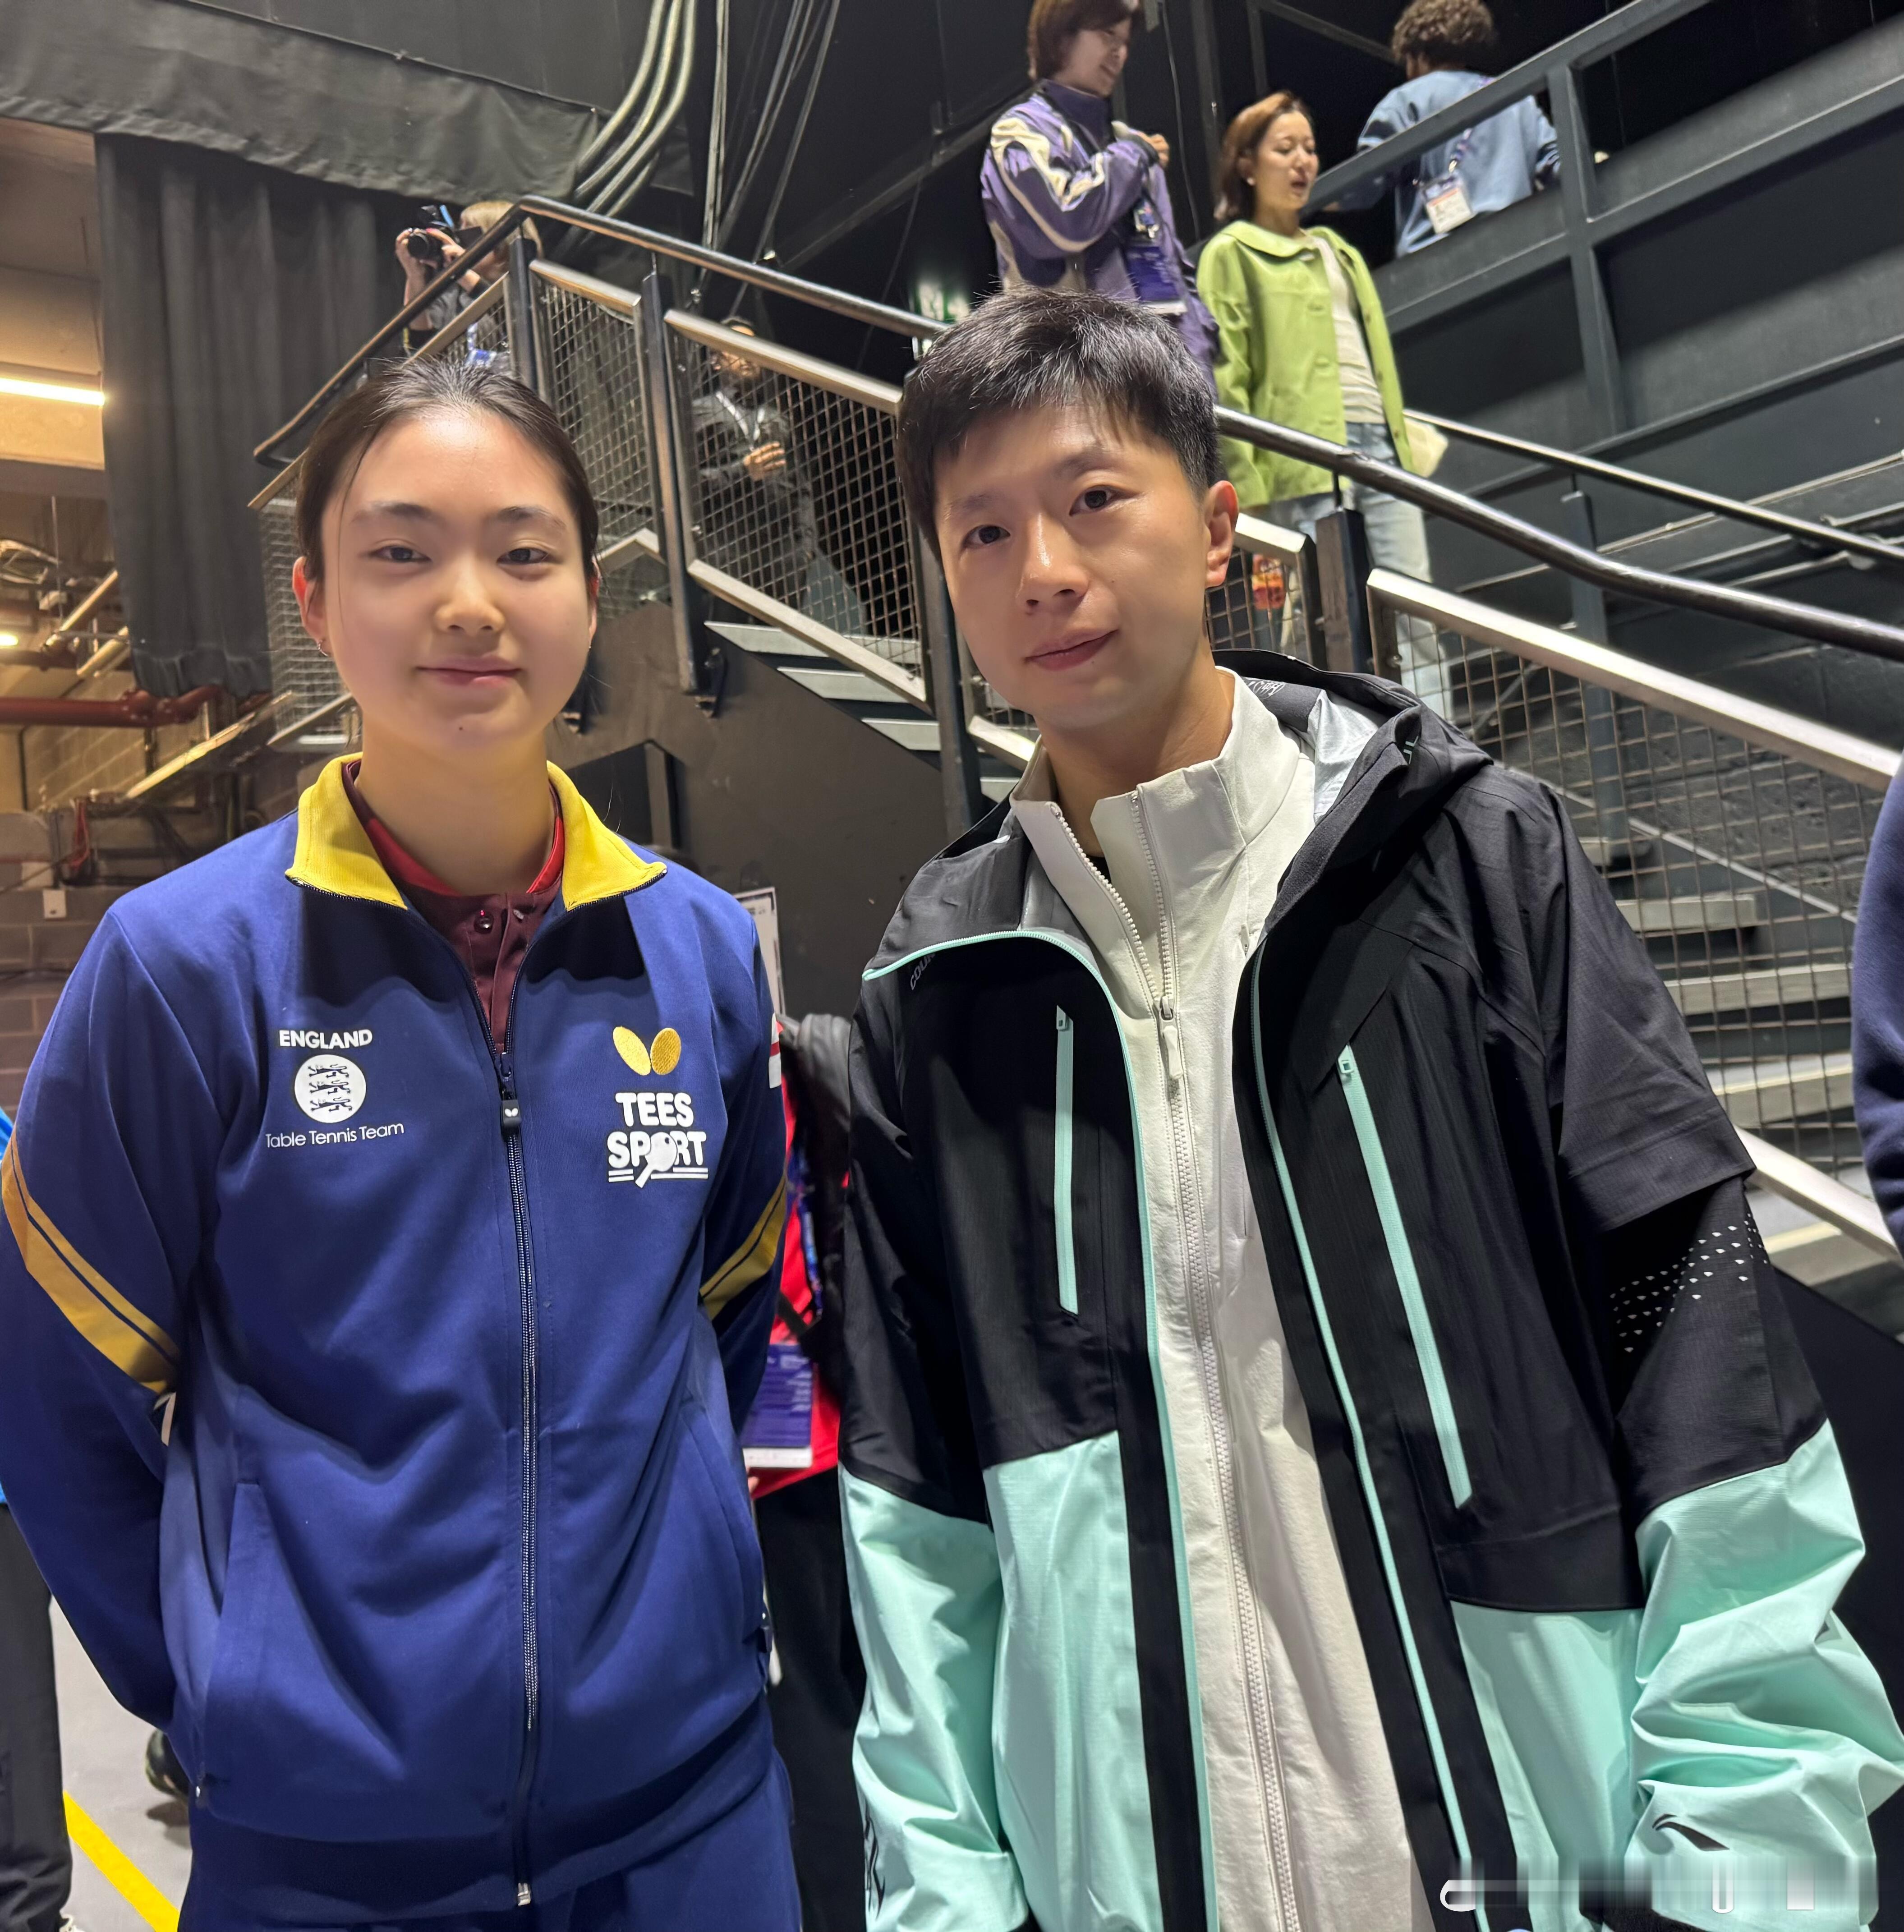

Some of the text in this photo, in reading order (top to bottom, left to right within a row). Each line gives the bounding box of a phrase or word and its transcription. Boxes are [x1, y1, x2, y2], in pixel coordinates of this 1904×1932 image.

[279, 1029, 373, 1050] ENGLAND
[615, 1092, 694, 1128] TEES
[265, 1122, 405, 1148] Table Tennis Team
[607, 1131, 707, 1169] SPORT
